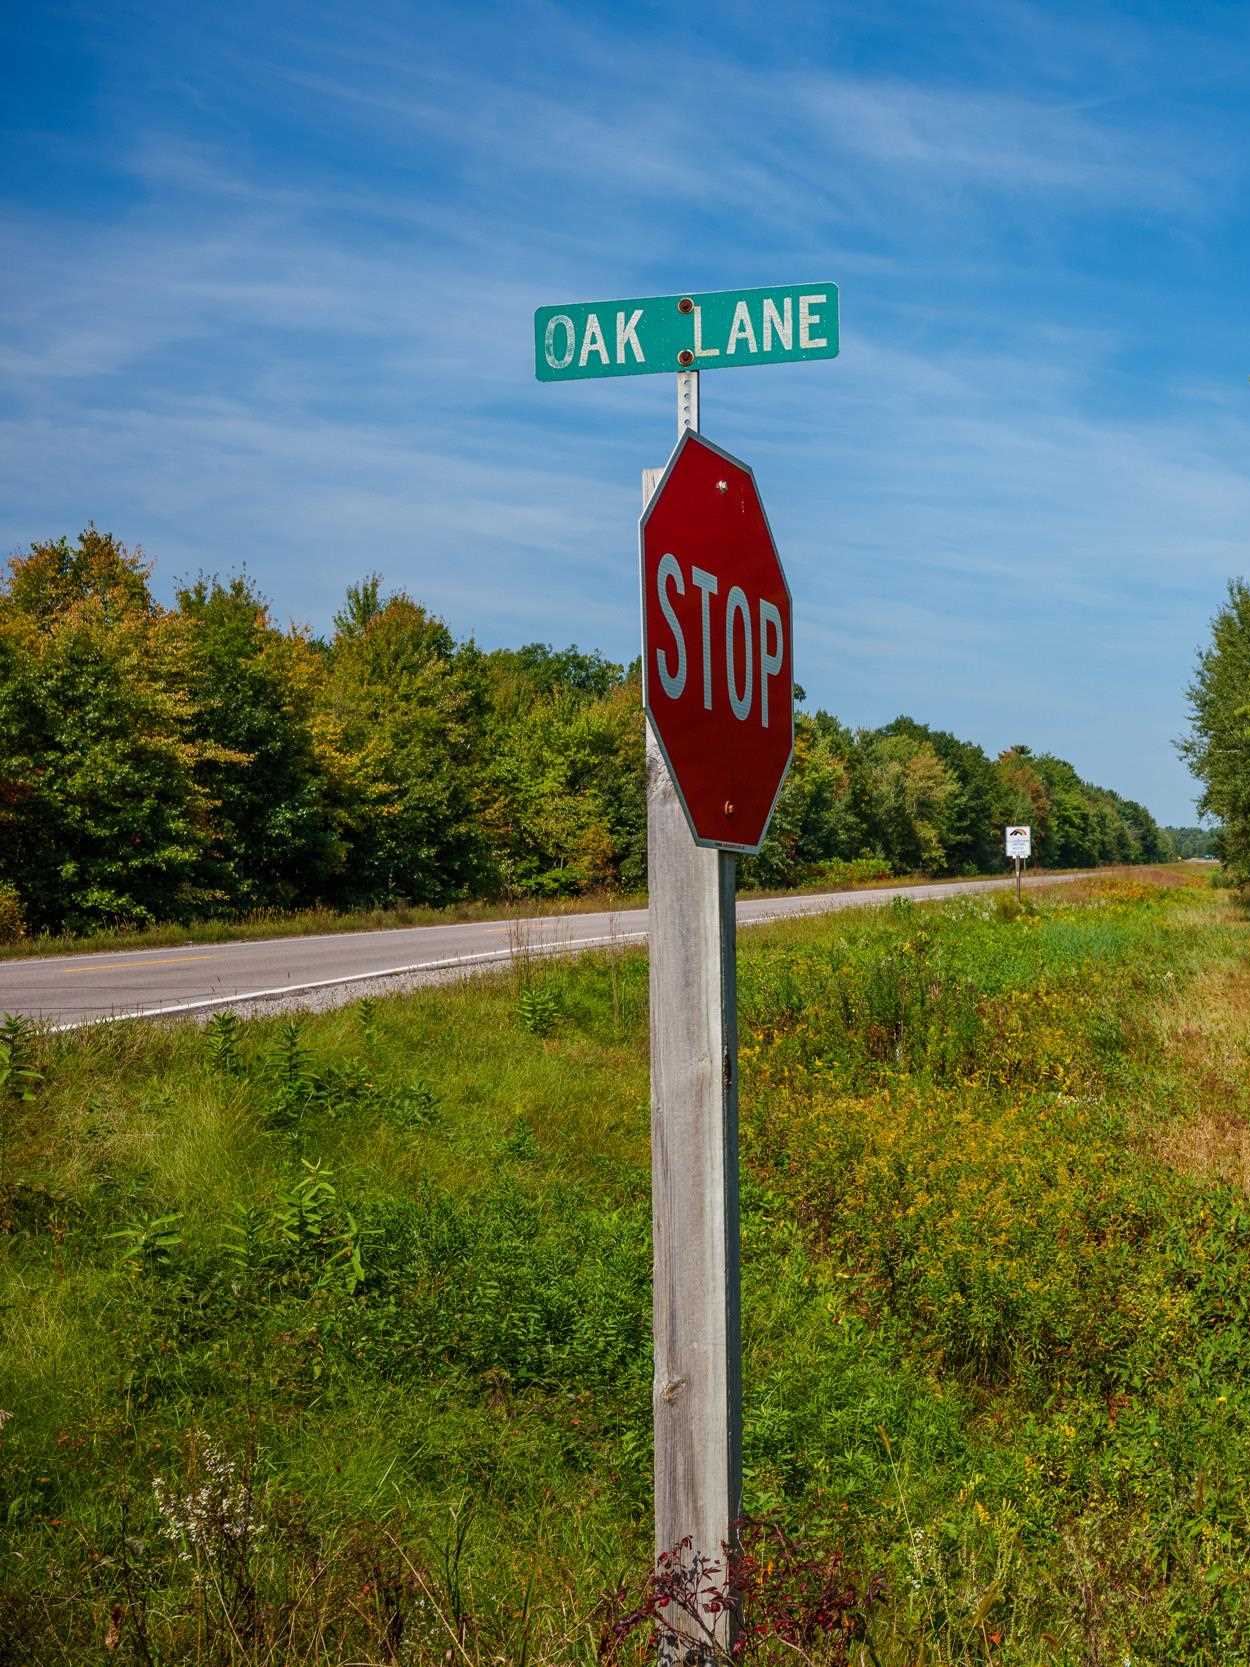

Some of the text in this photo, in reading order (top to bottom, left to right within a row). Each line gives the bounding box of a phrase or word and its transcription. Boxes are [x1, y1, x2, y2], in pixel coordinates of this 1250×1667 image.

[545, 294, 828, 369] OAK LANE
[656, 553, 783, 729] STOP
